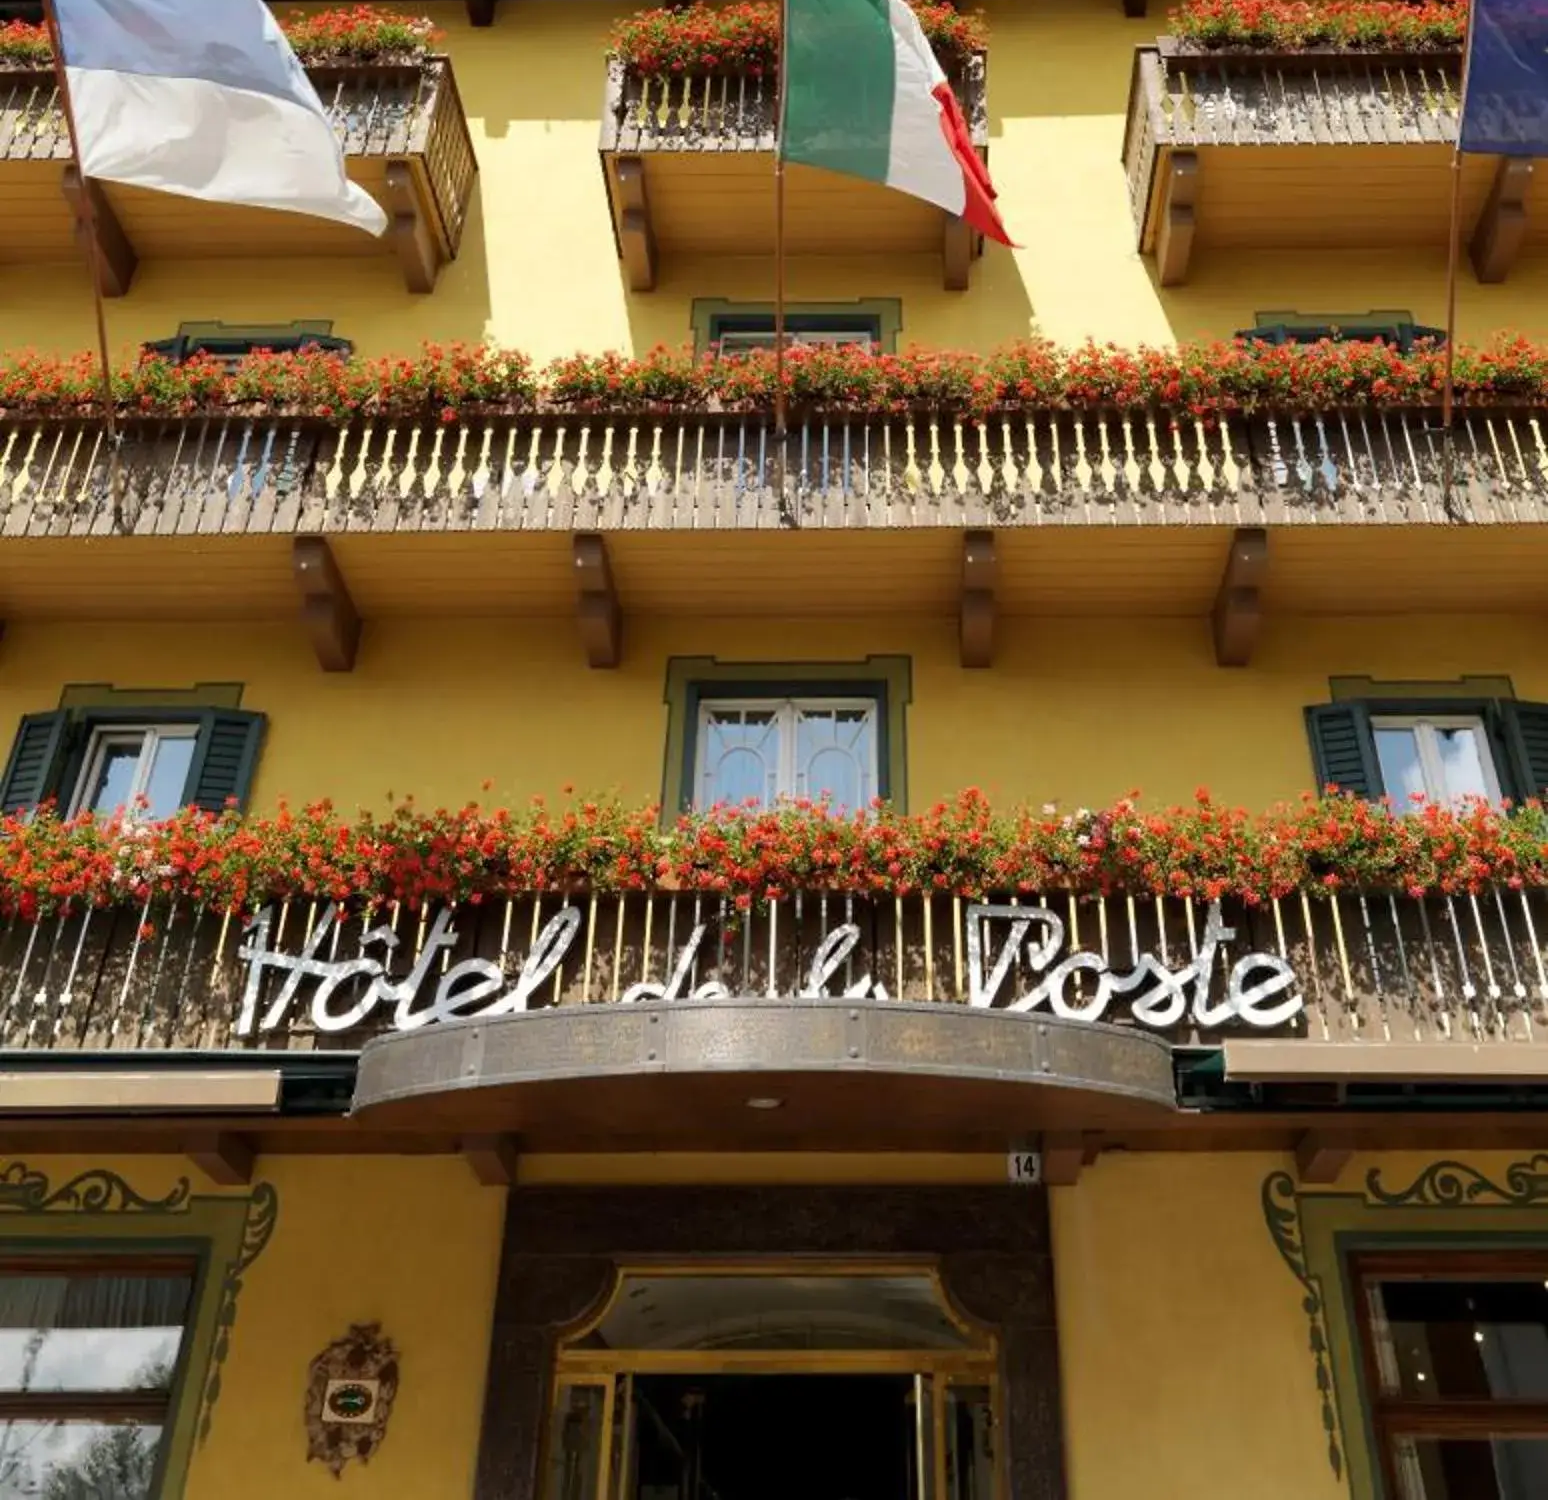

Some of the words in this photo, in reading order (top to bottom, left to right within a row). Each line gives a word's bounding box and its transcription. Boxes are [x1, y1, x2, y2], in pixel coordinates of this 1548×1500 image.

[238, 904, 582, 1035] Hôtel
[621, 923, 730, 1001] d
[966, 899, 1303, 1027] Poste
[1014, 1155, 1035, 1178] 14
